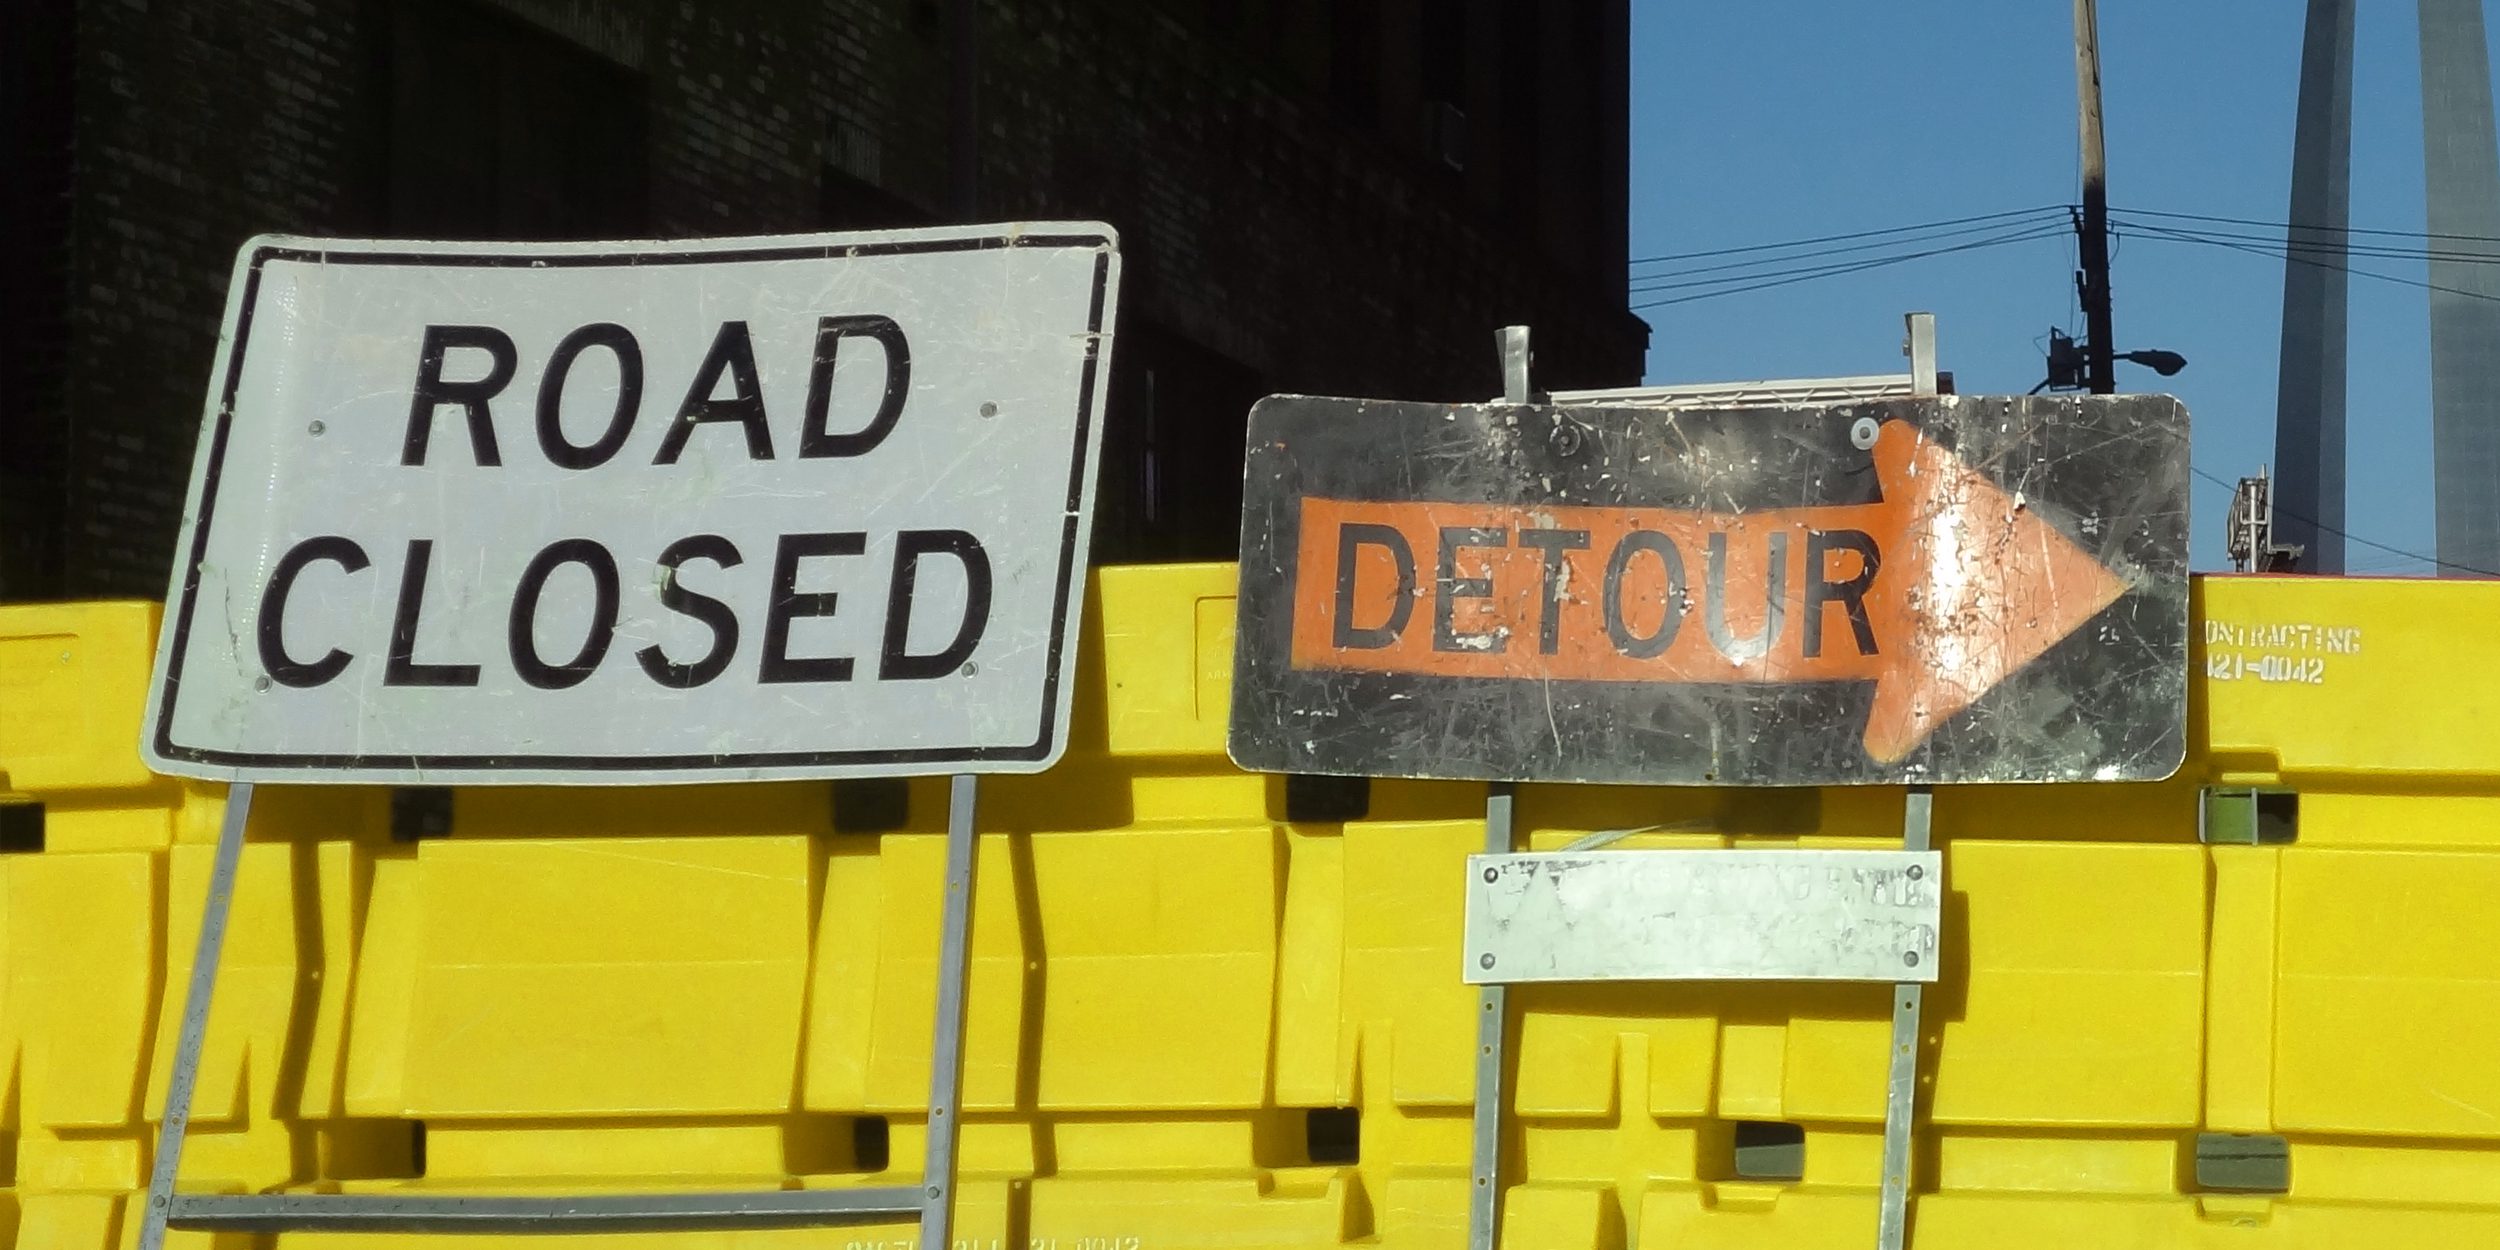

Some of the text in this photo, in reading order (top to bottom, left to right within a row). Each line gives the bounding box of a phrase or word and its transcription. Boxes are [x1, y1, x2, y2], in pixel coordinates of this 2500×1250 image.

[399, 314, 912, 470] ROAD
[256, 528, 993, 690] CLOSED
[1332, 521, 1880, 662] DETOUR
[2204, 619, 2361, 655] ONTRACTING
